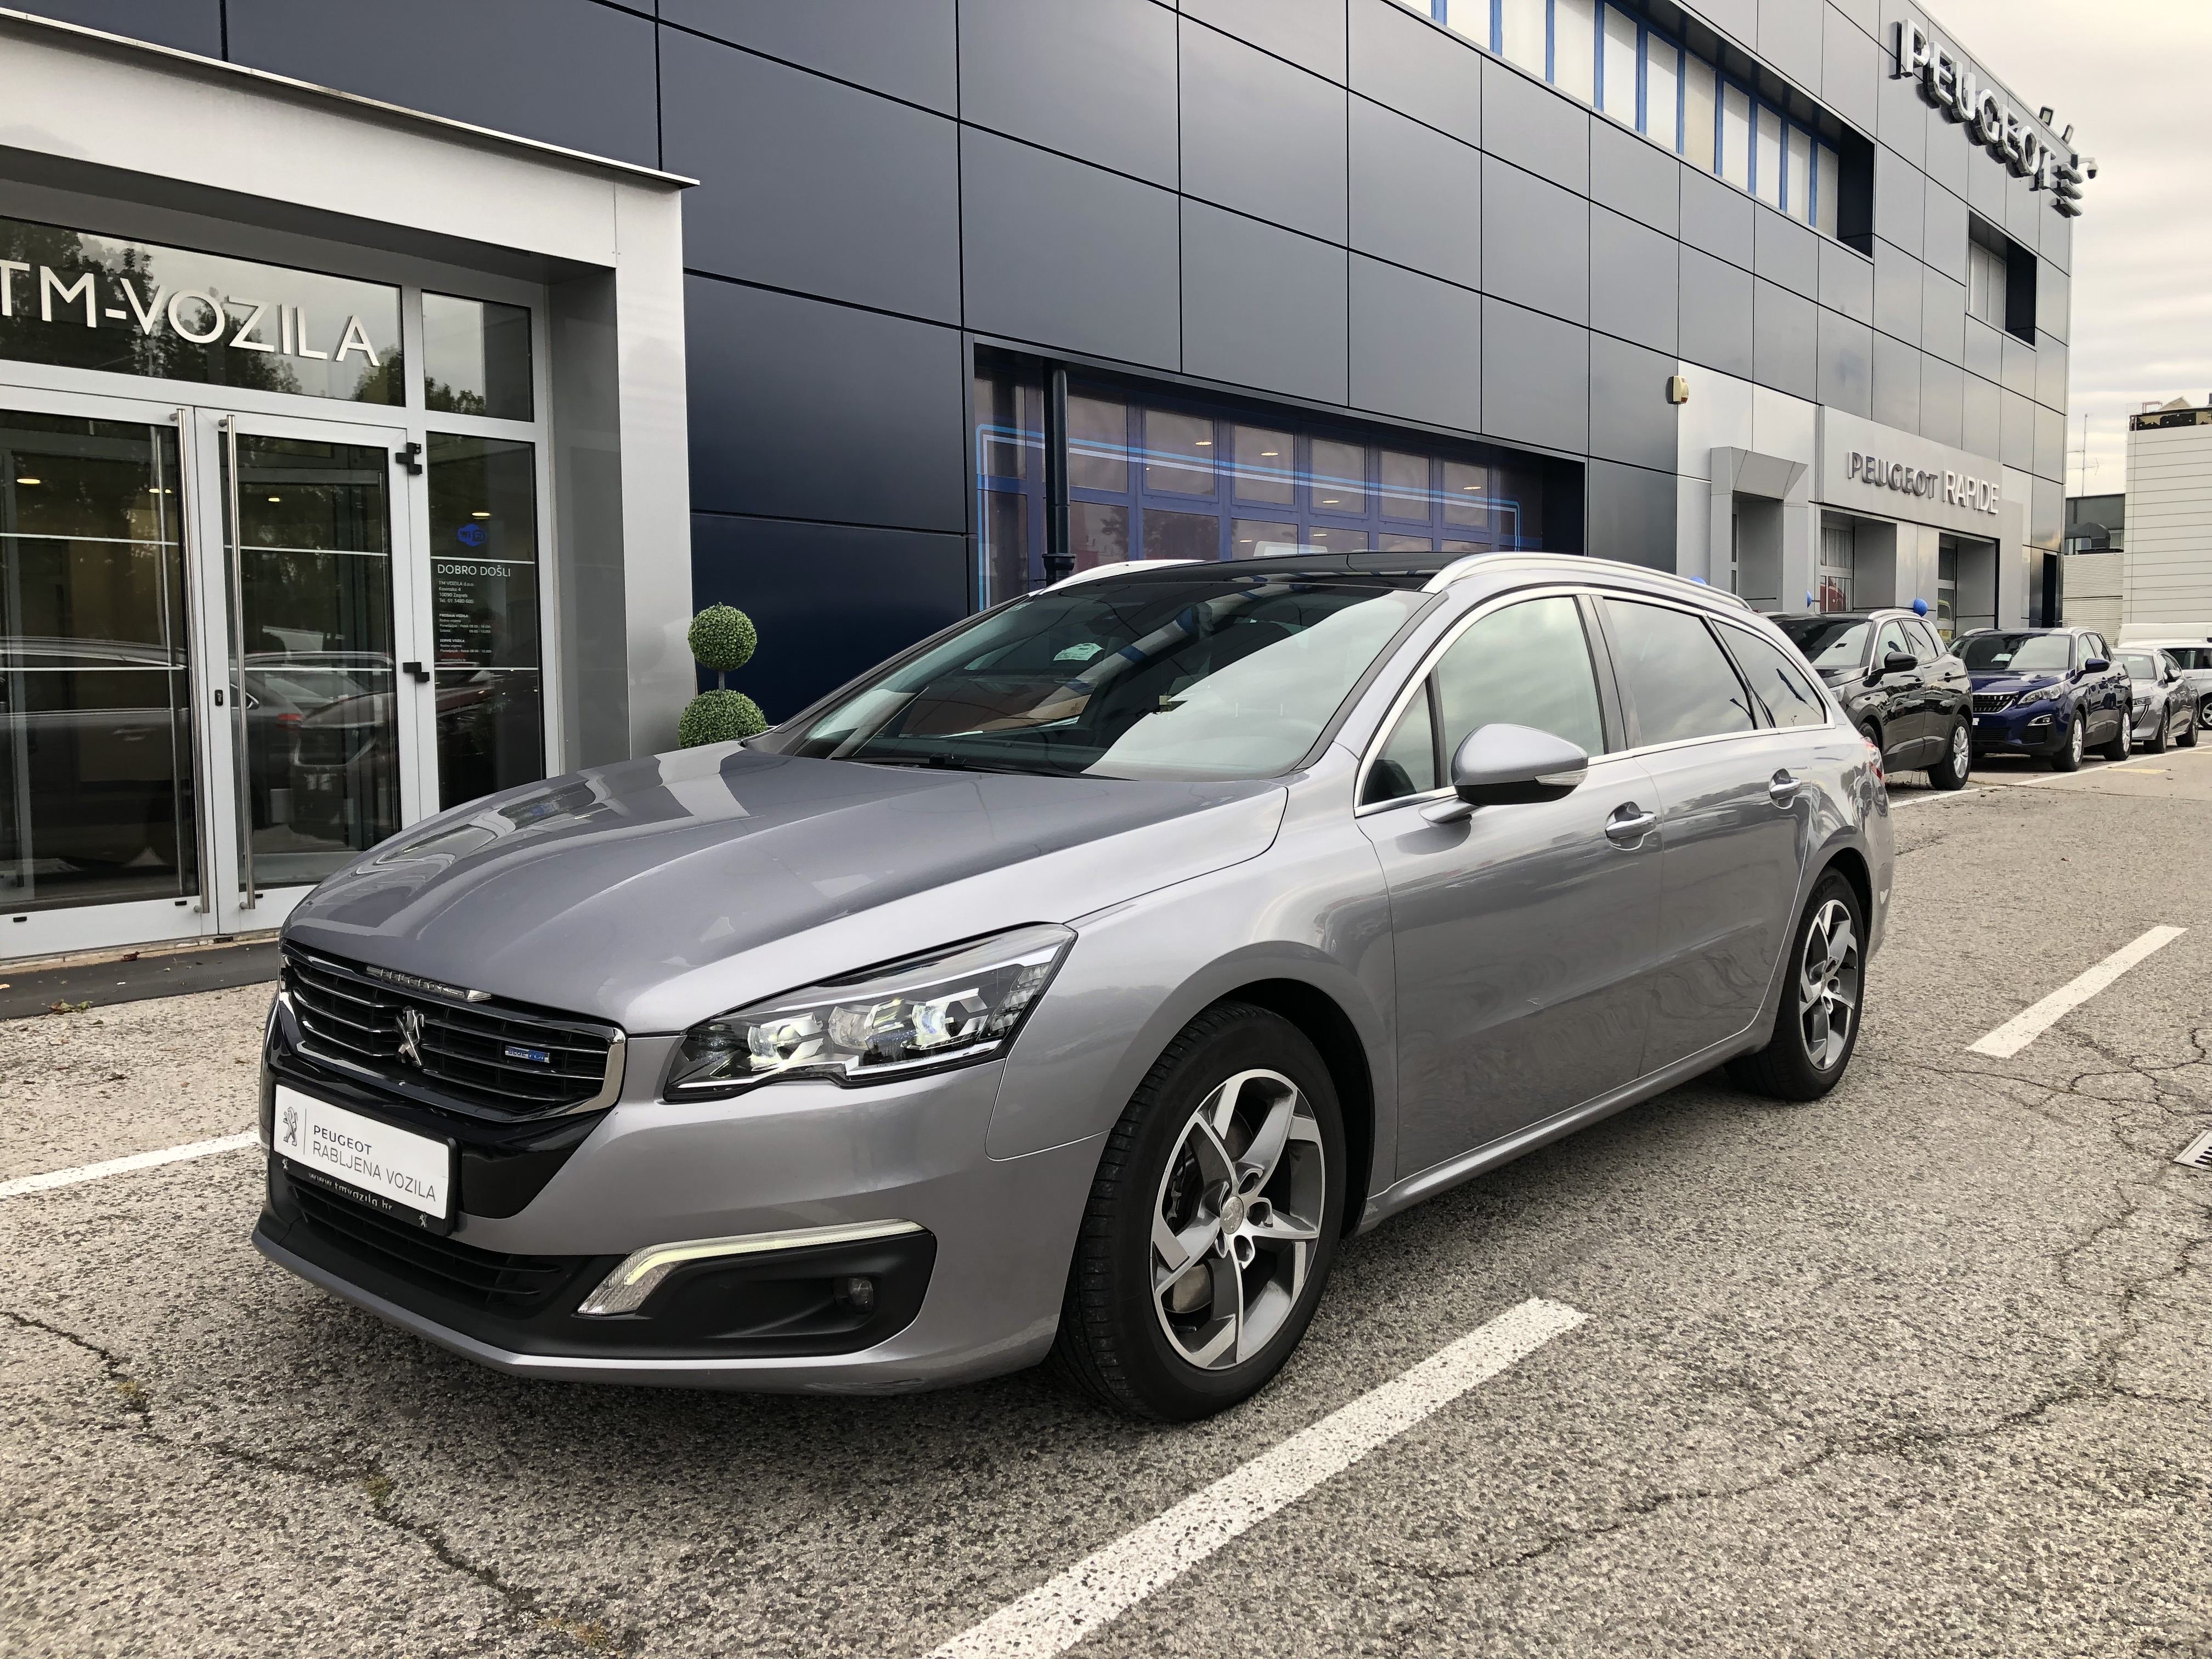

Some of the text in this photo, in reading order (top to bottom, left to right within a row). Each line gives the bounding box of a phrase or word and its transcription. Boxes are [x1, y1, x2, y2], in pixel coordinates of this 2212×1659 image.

[1891, 19, 2057, 190] PEUGEOT
[0, 259, 380, 367] TM-VOZILA
[1848, 452, 2000, 515] PEUGEOT RAPIDE
[437, 564, 511, 577] DOBRO DOŠLI
[314, 1125, 372, 1155] PEUGEOT
[313, 1141, 436, 1202] RABLJENA VOZILA
